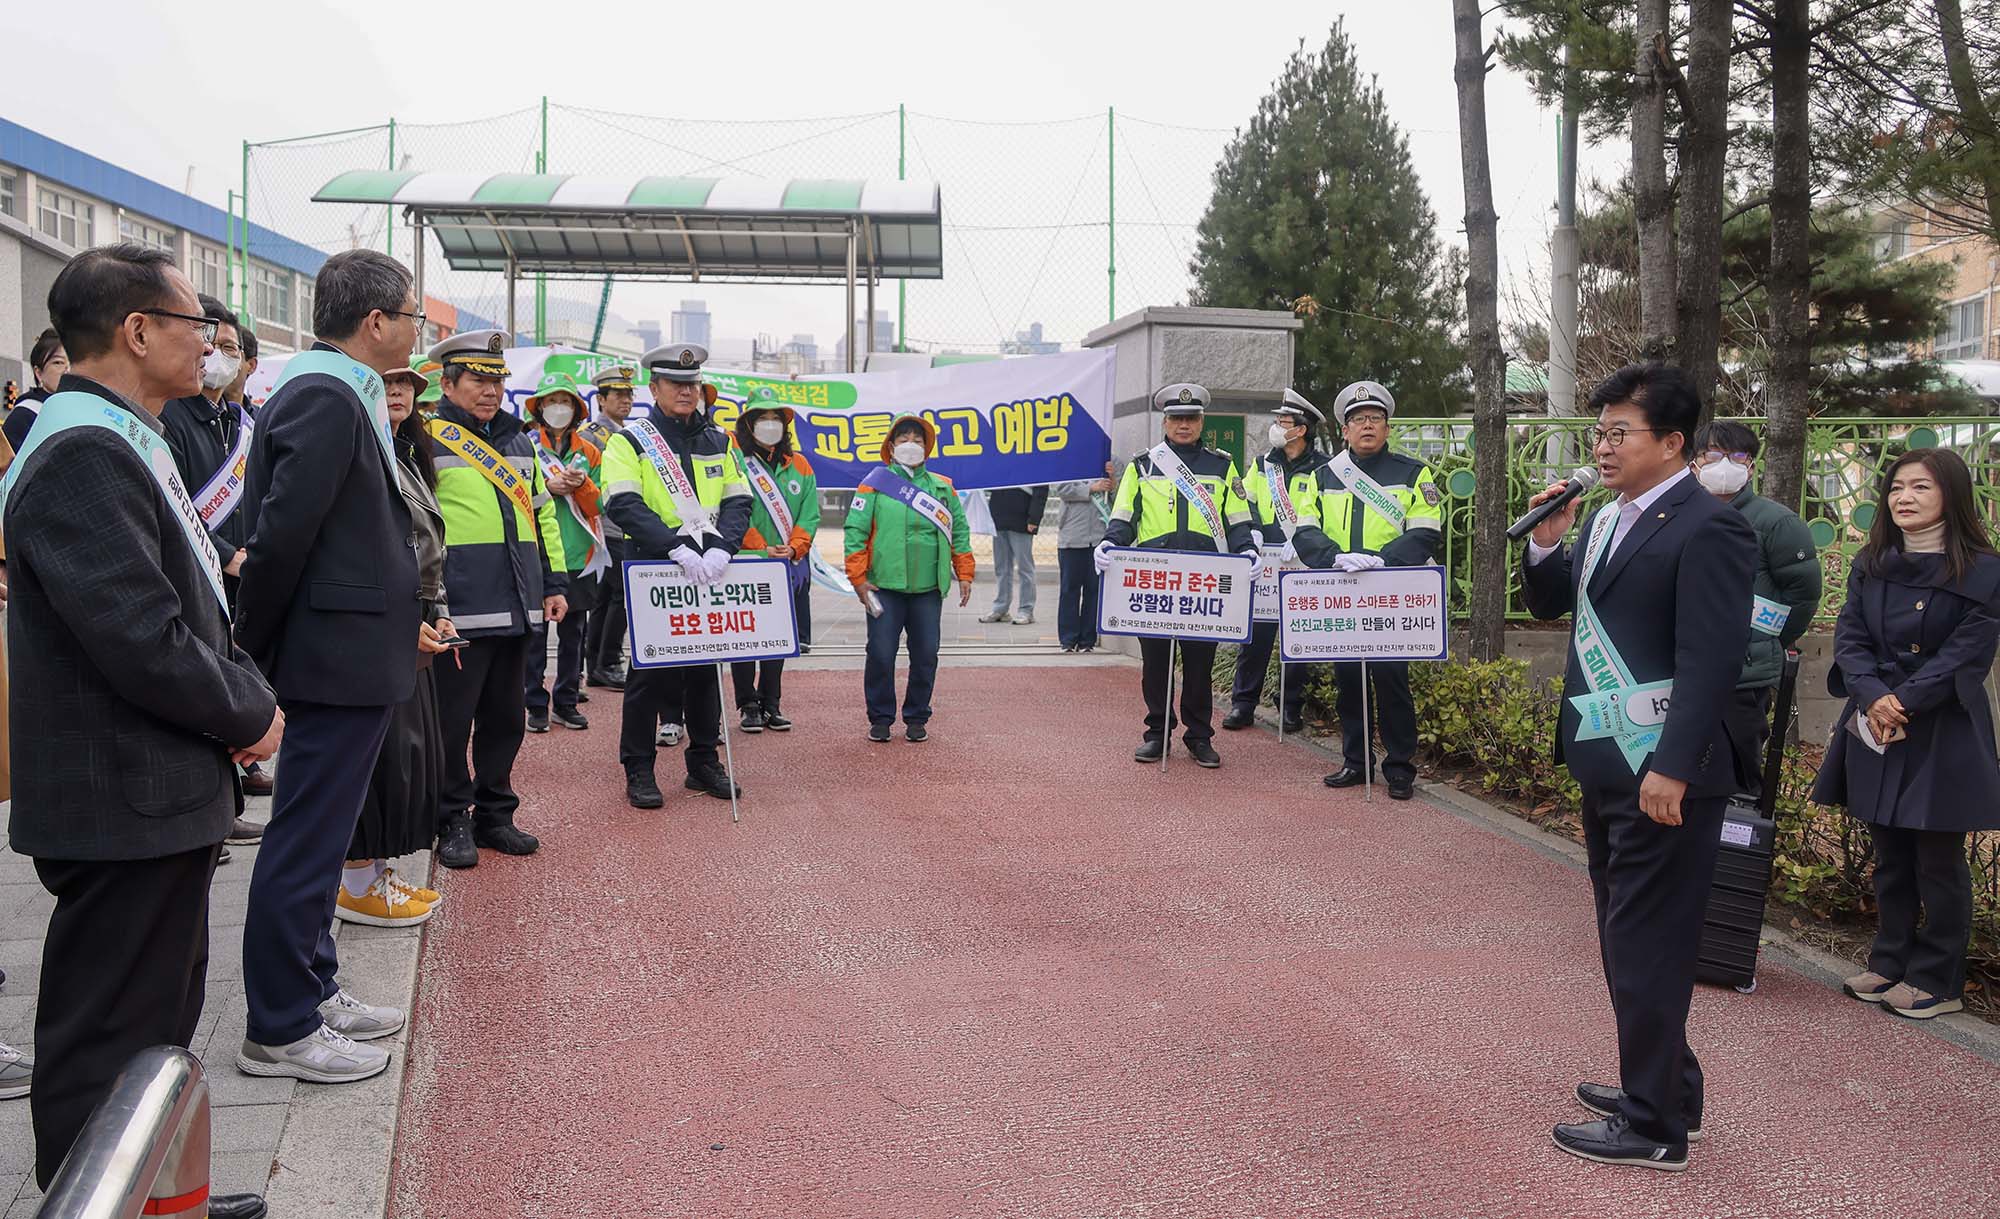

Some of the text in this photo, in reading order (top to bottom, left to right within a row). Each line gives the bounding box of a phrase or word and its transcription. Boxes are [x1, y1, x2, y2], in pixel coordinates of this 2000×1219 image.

[993, 395, 1073, 454] 예방
[461, 439, 498, 470] 안전을
[494, 465, 518, 489] 위해
[1122, 568, 1232, 595] 교통법규 준수를
[1128, 592, 1224, 618] 생활화 합시다
[1287, 593, 1437, 611] 운행중 DMB 스마트폰 안하기
[669, 610, 756, 637] 보호 합시다
[1120, 618, 1242, 634] 전국모범운전자연합회 대전지부 대덕지회
[1289, 616, 1436, 633] 선진교통문화 만들어 갑시다
[657, 639, 789, 656] 전국모범운전자연합회 대전지부 대덕지회
[1304, 643, 1436, 654] 전국모범운전자연합회 대전지부 대덕지회
